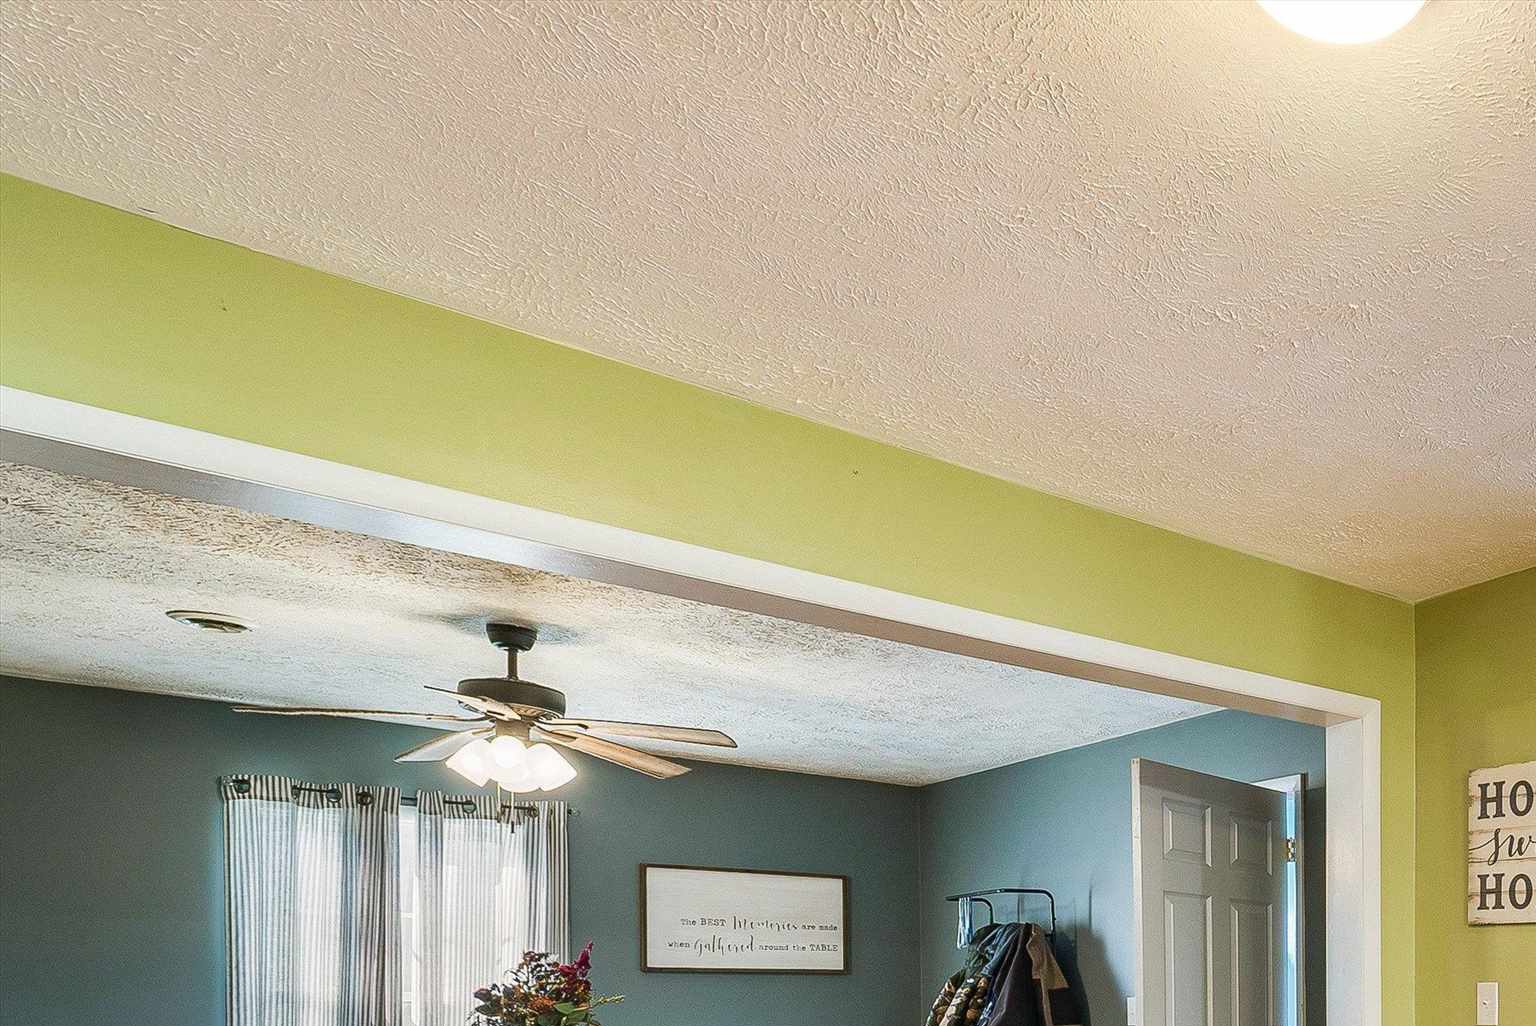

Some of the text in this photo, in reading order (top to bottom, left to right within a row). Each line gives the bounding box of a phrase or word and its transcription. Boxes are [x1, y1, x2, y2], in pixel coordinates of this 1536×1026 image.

[680, 918, 697, 928] The
[700, 917, 727, 927] BEST
[801, 924, 816, 932] are
[818, 924, 838, 932] made
[667, 940, 690, 949] when
[758, 944, 789, 952] around
[792, 943, 806, 951] the
[809, 943, 839, 952] TABLE
